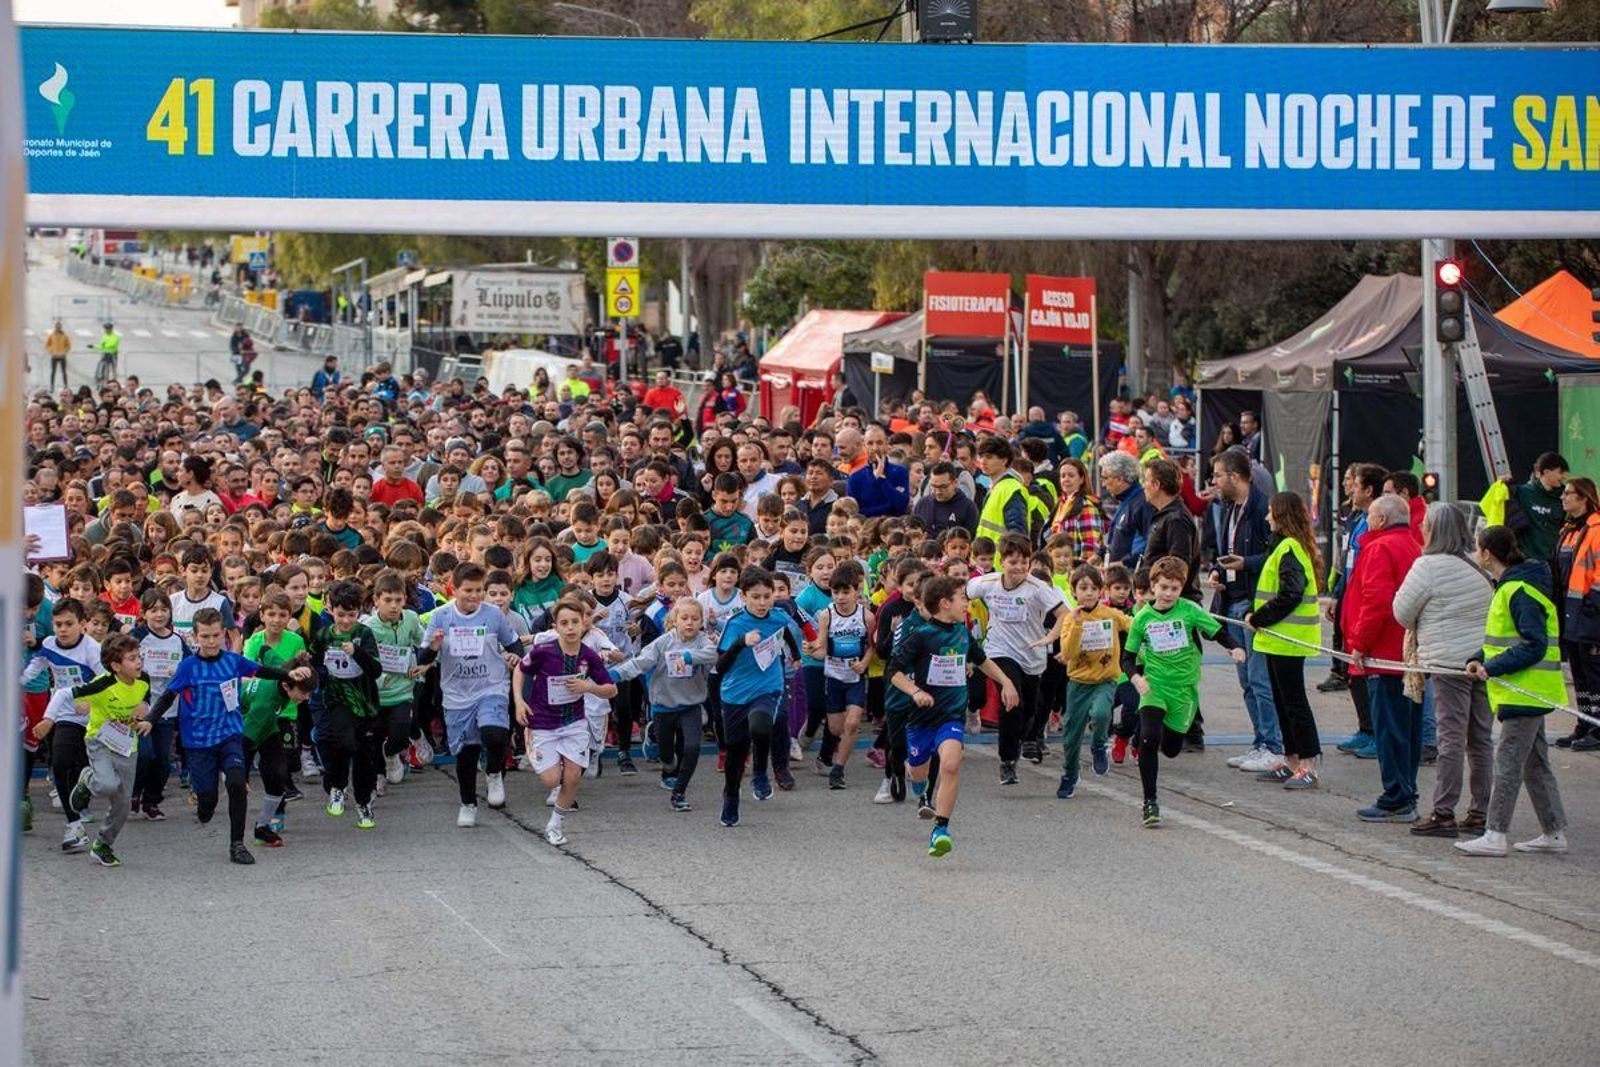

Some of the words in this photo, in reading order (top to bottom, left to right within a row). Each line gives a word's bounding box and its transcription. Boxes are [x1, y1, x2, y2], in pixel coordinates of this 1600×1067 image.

[146, 77, 214, 156] 41
[232, 79, 510, 161] CARRERA
[521, 83, 768, 164] URBANA
[789, 87, 1232, 168] INTERNACIONAL
[1244, 92, 1422, 170] NOCHE
[1431, 94, 1496, 171] DE
[56, 138, 99, 149] Municipal
[100, 139, 112, 148] de
[23, 148, 63, 158] Deportes
[65, 148, 77, 157] de
[79, 149, 101, 158] Jaén
[475, 286, 542, 312] Lúpulo
[928, 294, 1005, 313] FISIOTERAPIA
[948, 511, 957, 522] A
